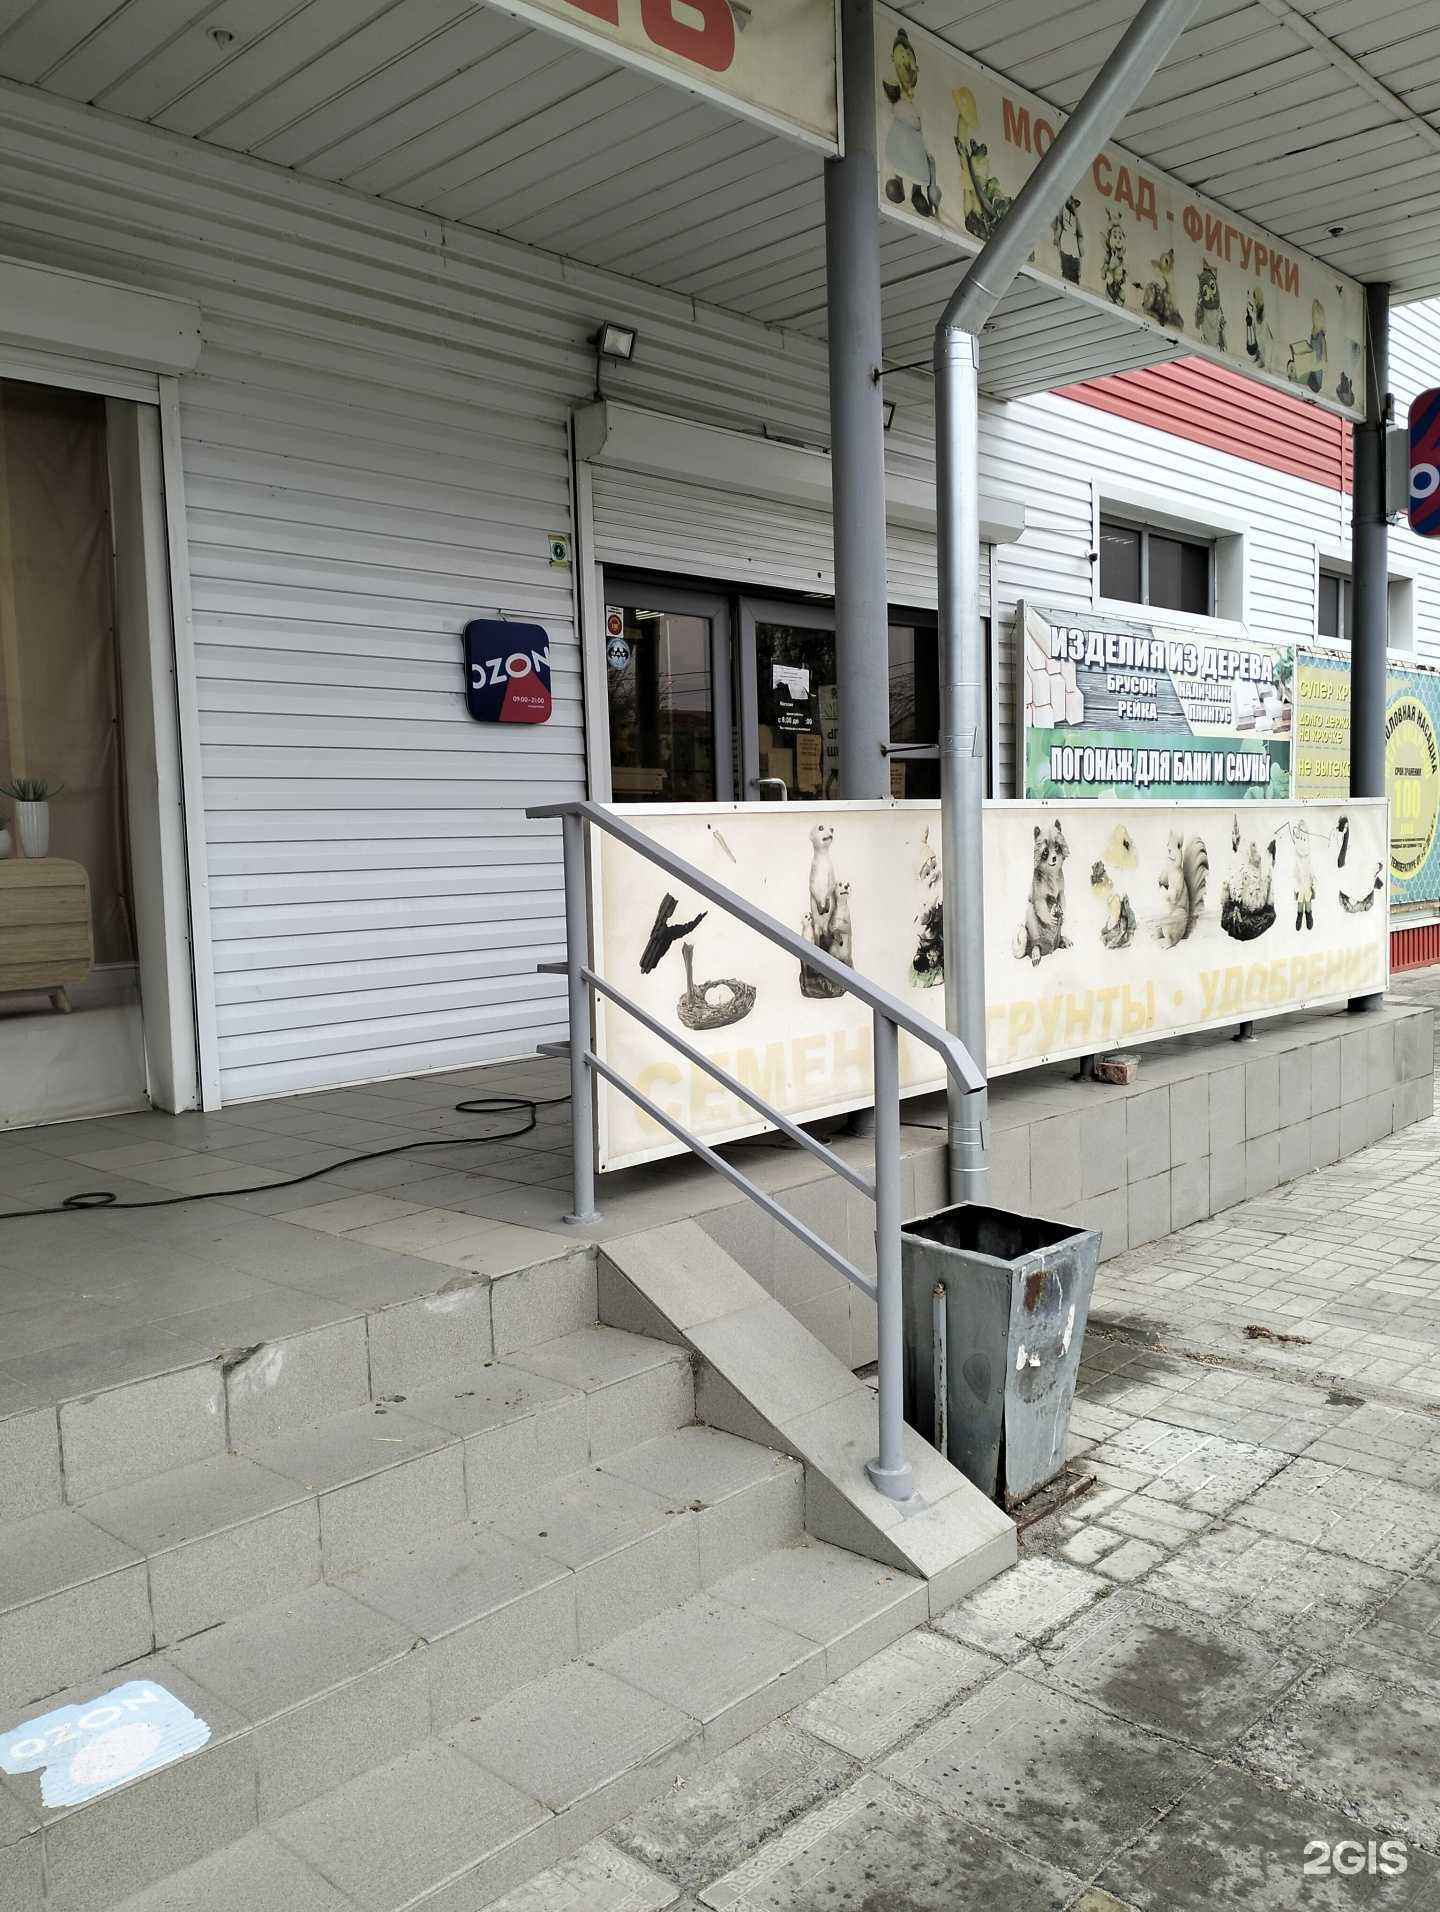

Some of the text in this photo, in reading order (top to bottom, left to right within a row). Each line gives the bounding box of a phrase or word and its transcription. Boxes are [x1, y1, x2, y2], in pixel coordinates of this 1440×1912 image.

[1002, 97, 1056, 160] МО
[1093, 154, 1158, 231] САД
[1183, 205, 1299, 296] ФИГУРКИ
[471, 646, 551, 690] OZON
[1051, 626, 1274, 683] ИЗДЕЛИЯ ИЗ ДЕРЕВА
[1106, 674, 1158, 697] БРУСОК
[1177, 681, 1232, 704] НАЛИЧНИК
[1118, 699, 1158, 721] РЕЙКА
[1187, 704, 1232, 724] ПЛИНТУС
[1385, 704, 1438, 775] ОЛОВНАЯ НАСАДКА
[1050, 746, 1272, 788] ПОГОНАЖ ДЛЯ БАНИ И САУНЫ
[1394, 779, 1421, 818] 100
[1199, 942, 1380, 1019] УДОБРЕНИЯ
